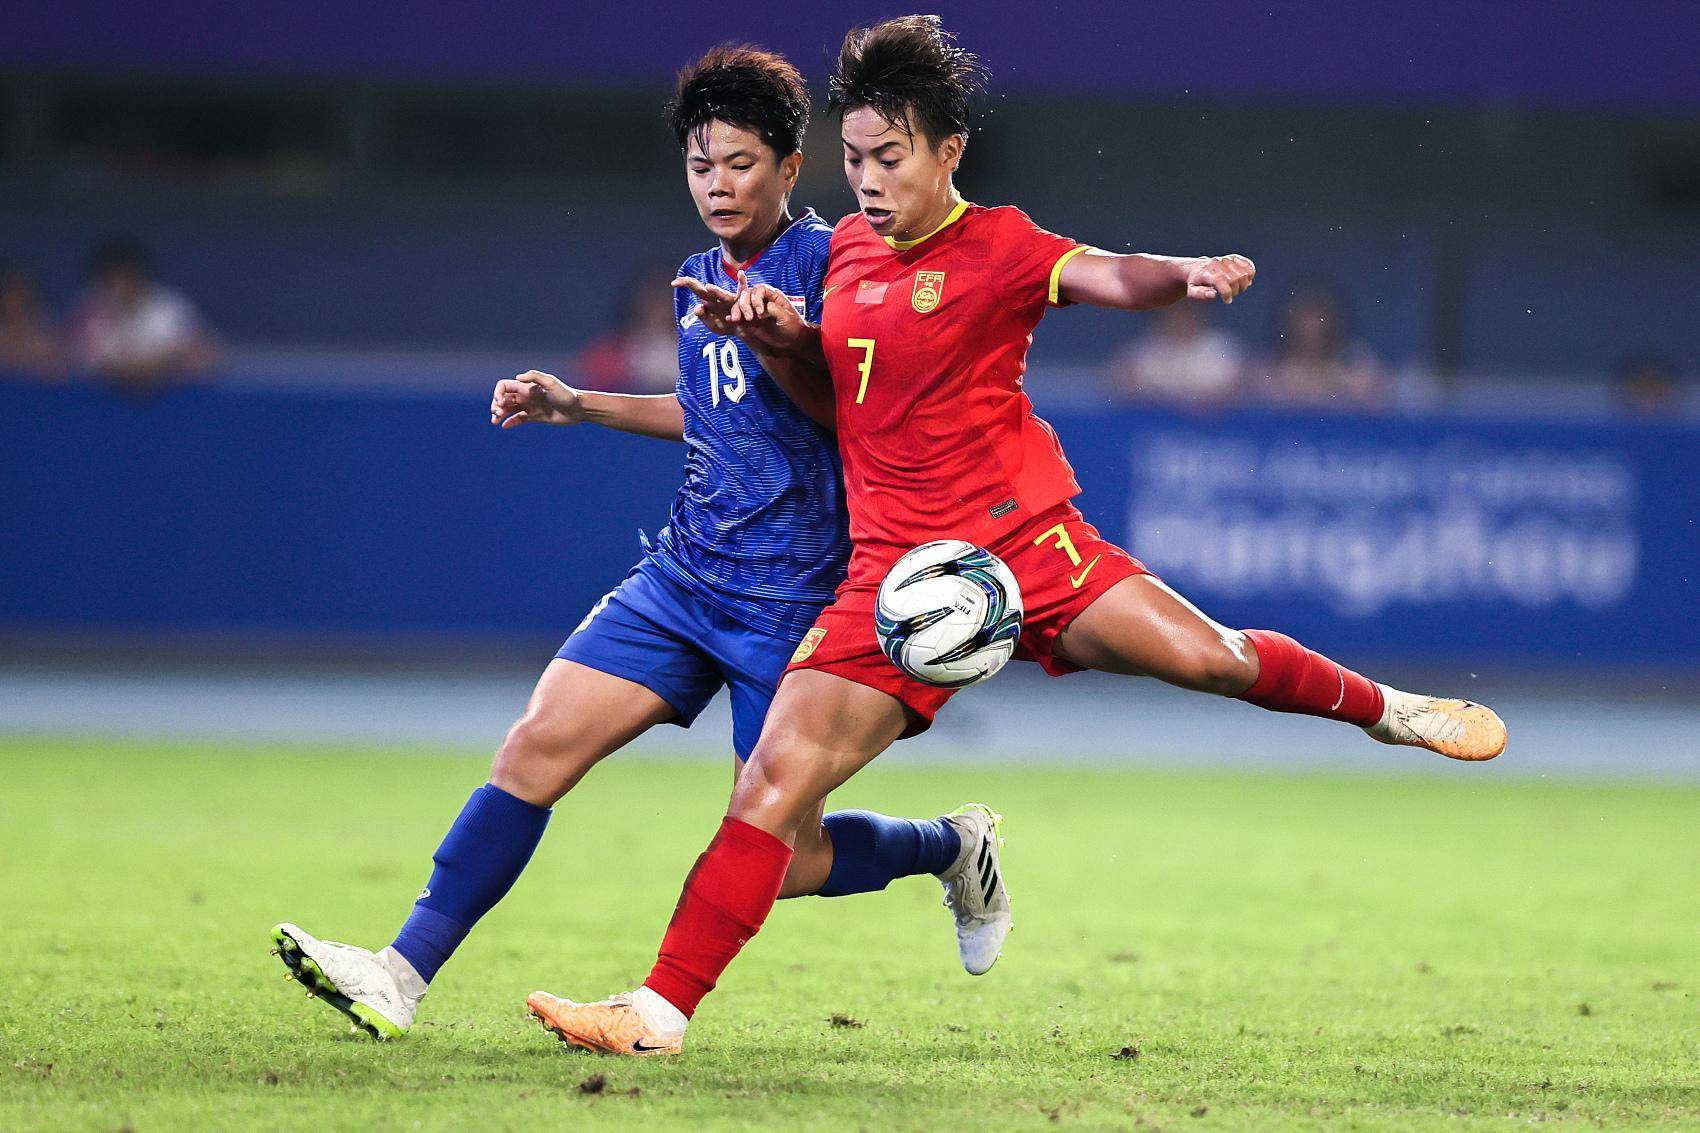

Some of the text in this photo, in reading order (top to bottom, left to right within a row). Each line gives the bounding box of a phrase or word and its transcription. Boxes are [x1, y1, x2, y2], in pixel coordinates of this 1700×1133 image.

[919, 273, 942, 282] CFA
[703, 338, 747, 409] 19
[847, 337, 876, 405] 7
[1033, 523, 1083, 567] 7
[954, 600, 971, 615] FIFA
